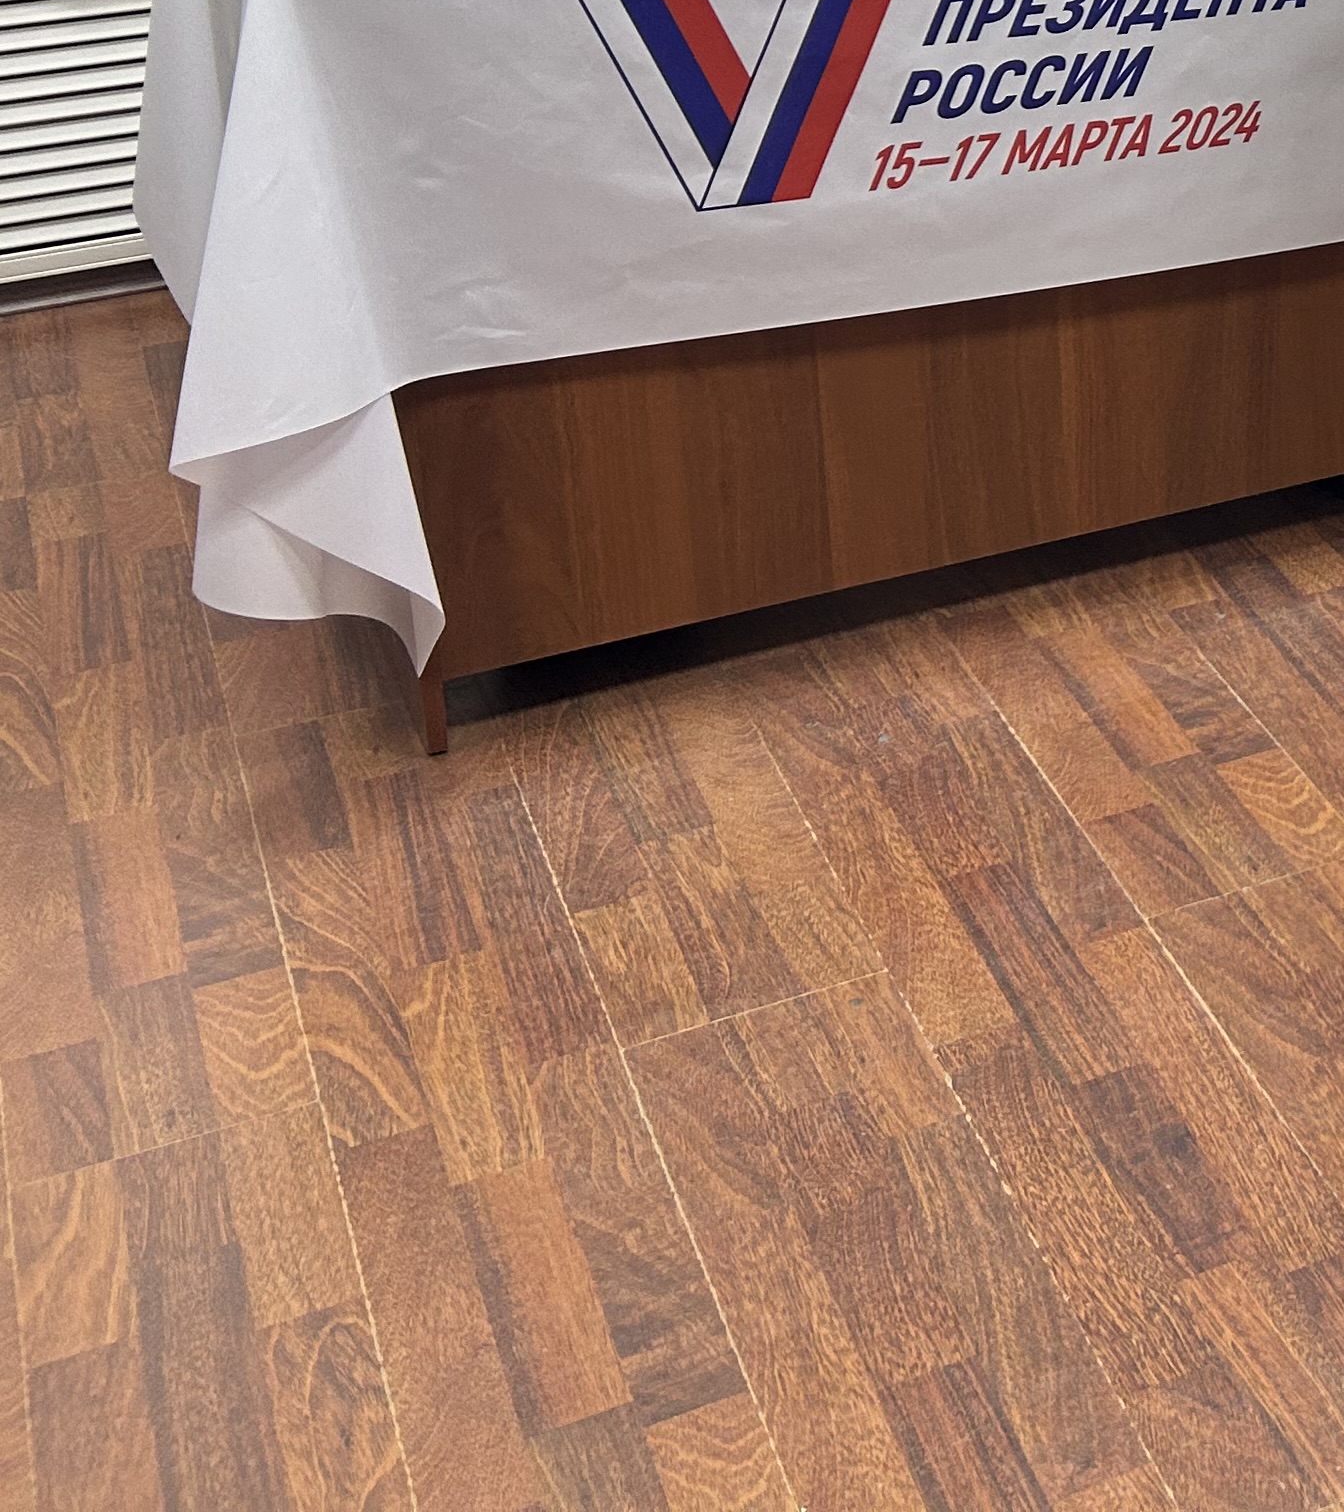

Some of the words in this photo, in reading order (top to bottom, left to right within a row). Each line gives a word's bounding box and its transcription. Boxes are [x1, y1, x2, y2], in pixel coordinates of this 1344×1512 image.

[890, 46, 1154, 125] РОССИИ
[1001, 114, 1152, 178] МАРТА
[1158, 101, 1263, 154] 2024
